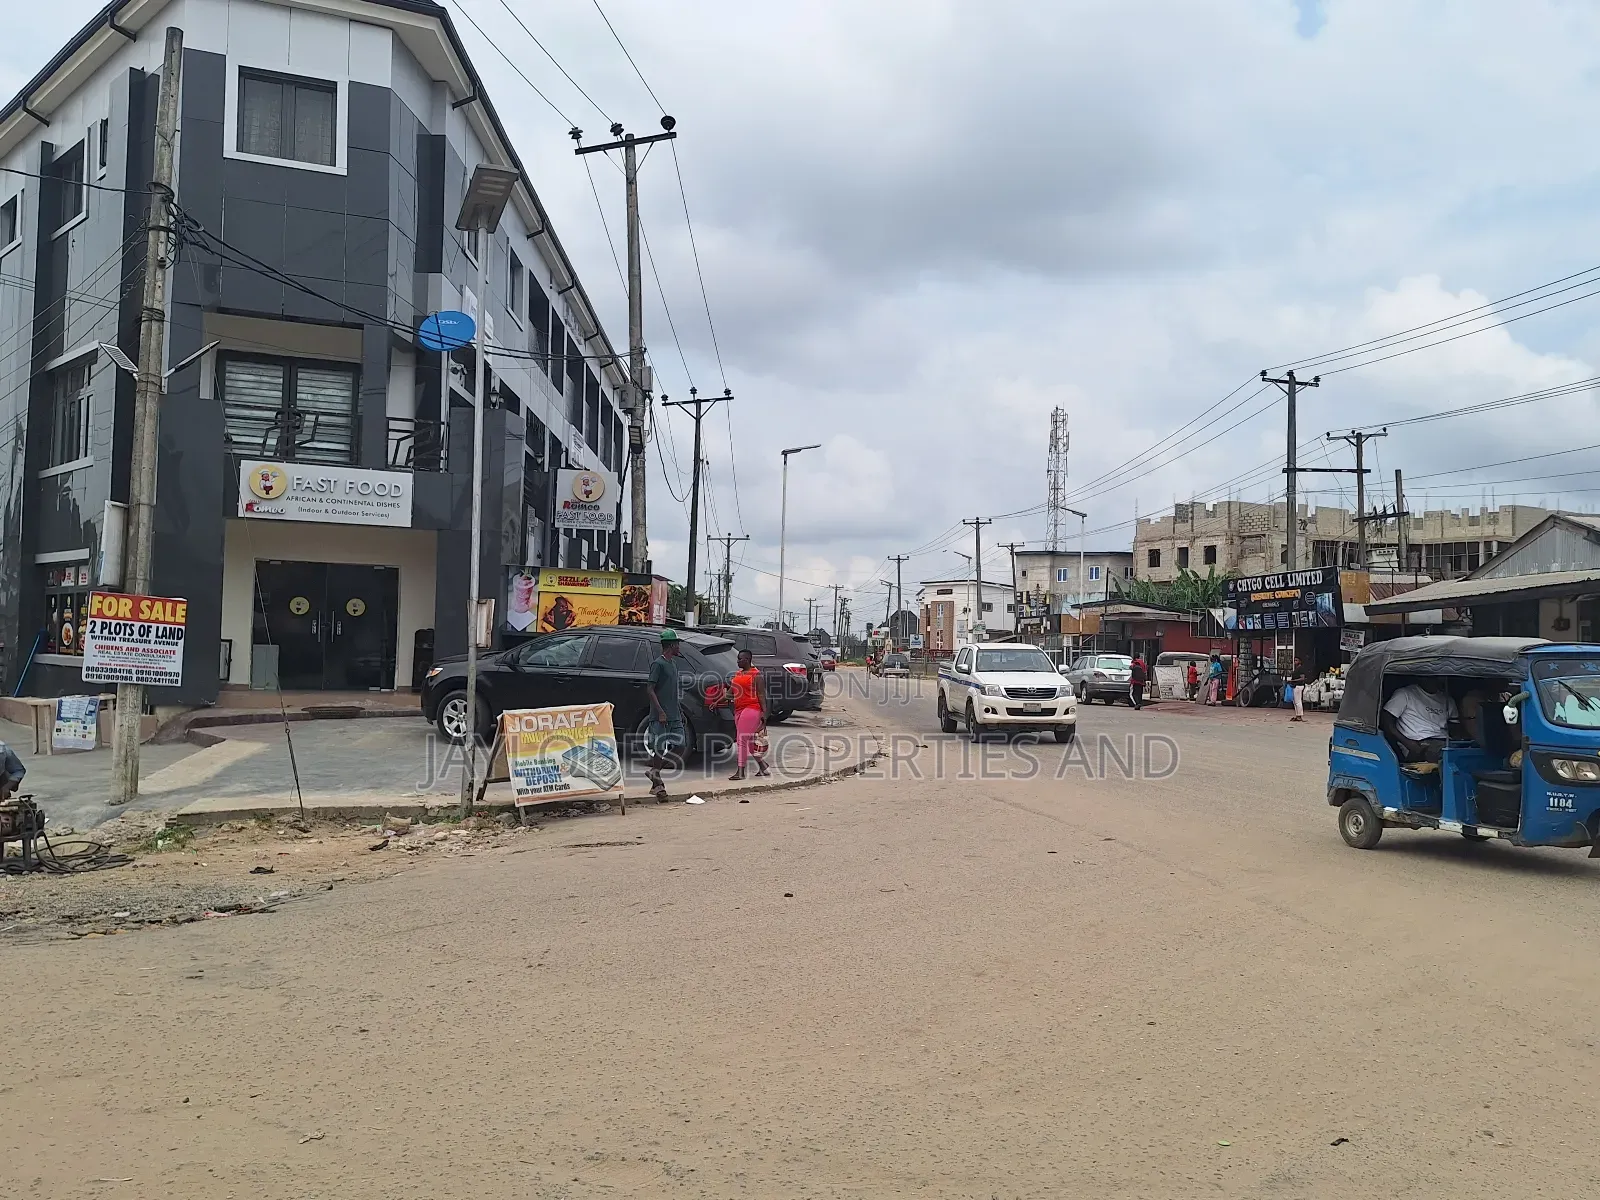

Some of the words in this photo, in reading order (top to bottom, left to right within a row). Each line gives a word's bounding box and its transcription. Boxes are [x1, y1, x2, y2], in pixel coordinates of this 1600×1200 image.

[292, 475, 338, 493] FAST
[345, 479, 404, 498] FOOD
[286, 495, 317, 503] AFRICAN
[326, 498, 374, 508] CONTINENTAL
[376, 501, 400, 509] DISHES
[298, 506, 323, 514] (Indoor
[332, 508, 360, 516] Outdoor
[362, 510, 390, 519] Services)
[556, 510, 581, 520] FAST
[584, 512, 614, 522] FOOD
[558, 575, 589, 584] SIZZLG
[1236, 578, 1262, 592] CHYGO
[1264, 574, 1285, 590] CELL
[1287, 570, 1324, 587] LIMITED
[91, 595, 133, 618] FOR
[138, 600, 187, 624] SALE
[89, 620, 96, 634] 2
[100, 620, 135, 637] PLOTS
[138, 624, 152, 638] OF
[154, 626, 184, 641] LAND
[118, 636, 152, 645] TREASURE
[153, 639, 179, 647] AVENUE
[94, 644, 124, 652] CHIBENS
[141, 647, 176, 656] ASSOCIATE
[507, 710, 600, 733] JORAFA
[534, 757, 556, 766] Banking
[514, 765, 560, 778] WITHDRAW
[560, 762, 570, 773] &
[526, 773, 562, 786] DEPOSIT
[543, 784, 554, 792] ATM
